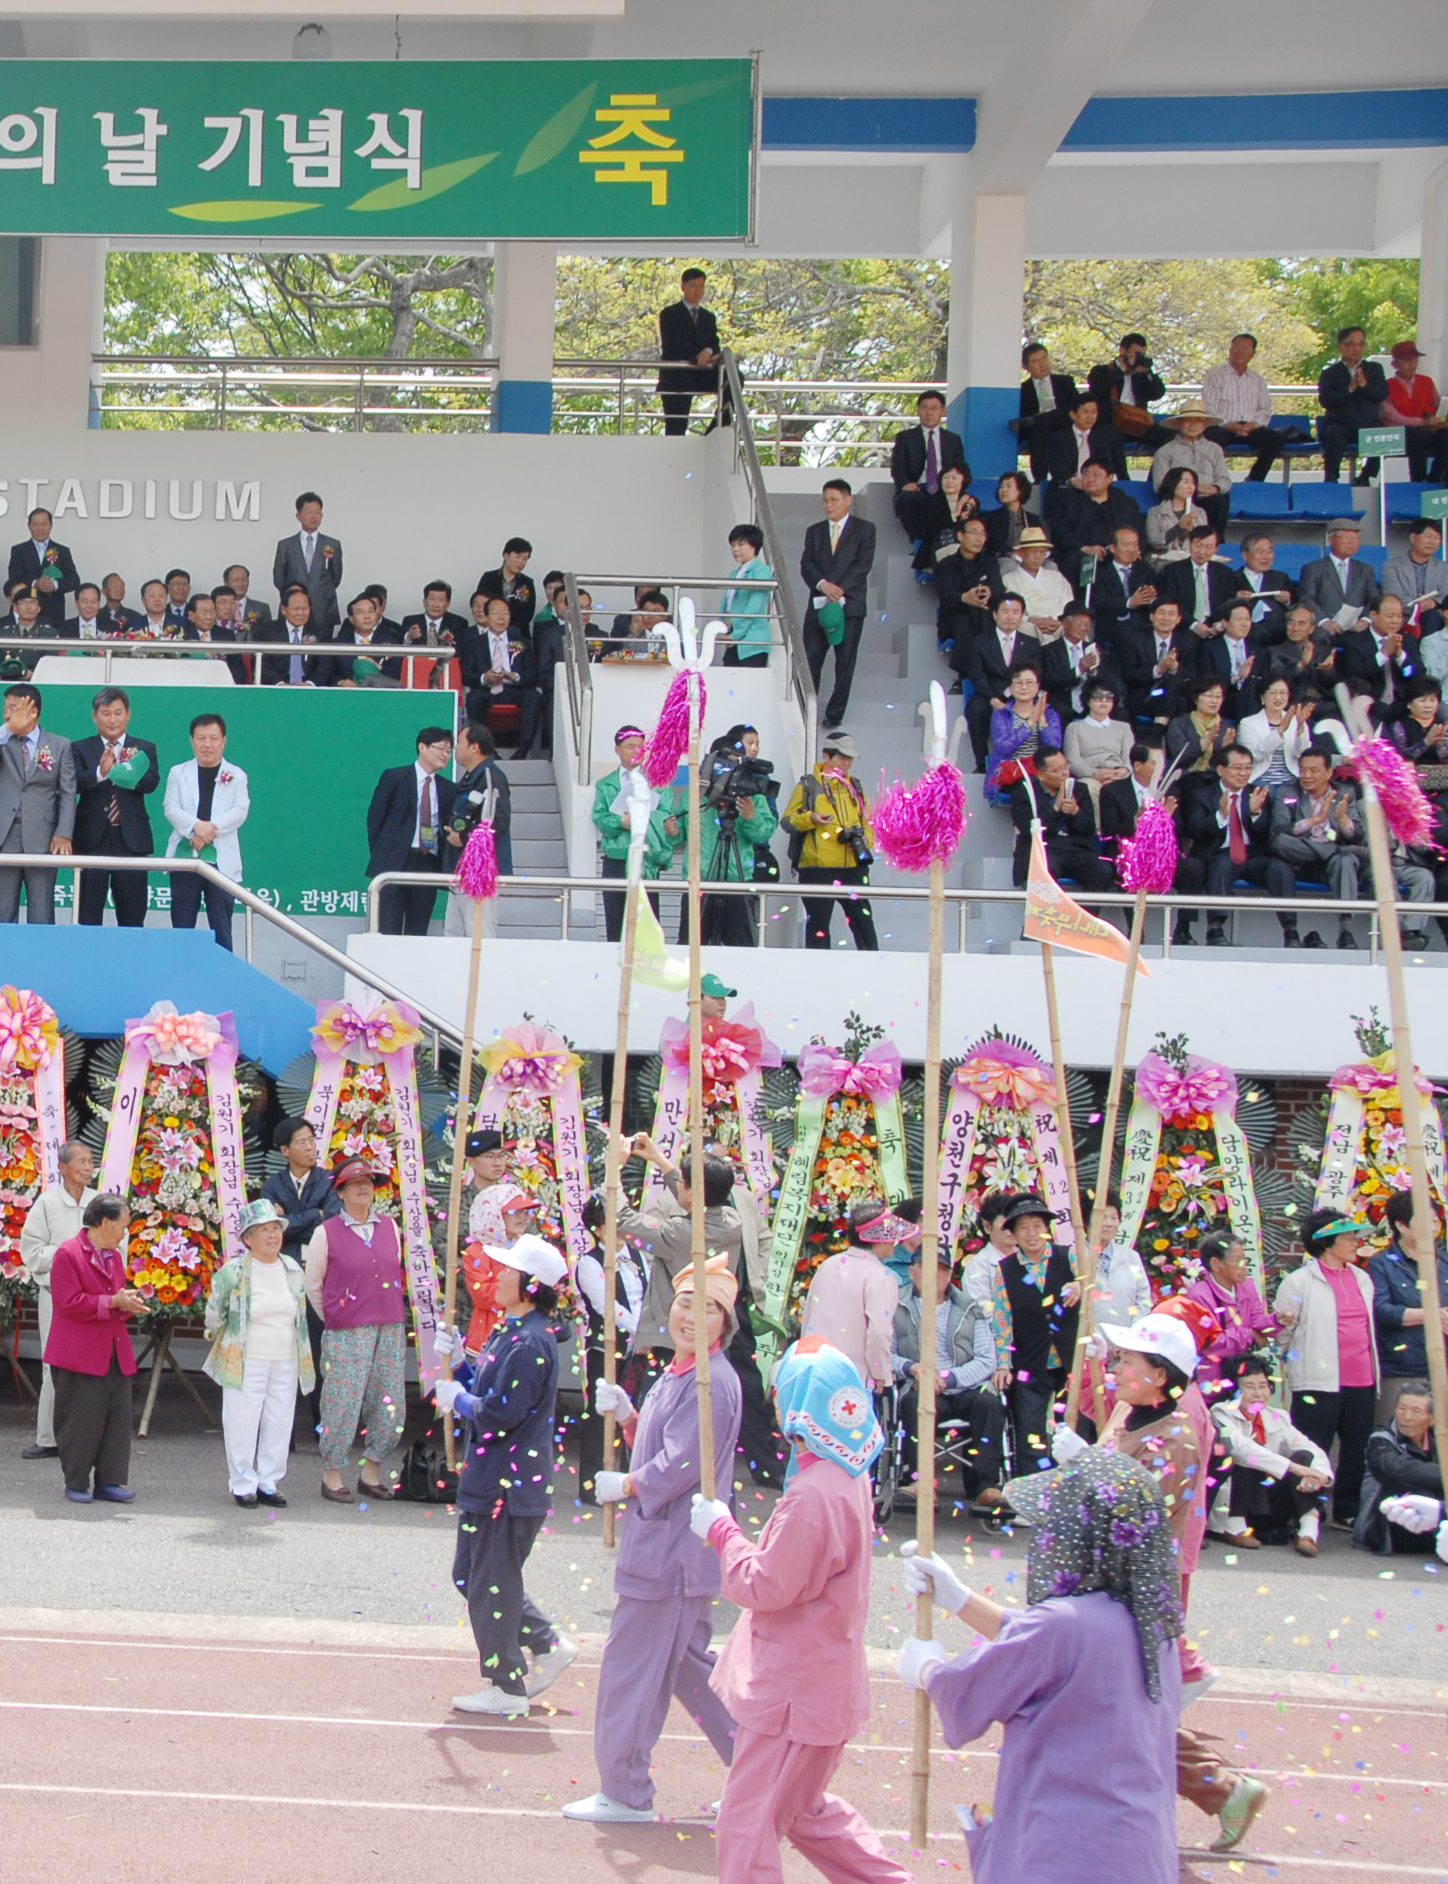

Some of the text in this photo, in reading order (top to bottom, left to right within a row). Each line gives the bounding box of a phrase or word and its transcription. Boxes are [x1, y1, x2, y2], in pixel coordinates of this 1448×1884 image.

[93, 107, 168, 187] 날
[198, 108, 424, 190] 기념식
[579, 93, 686, 206] 축
[216, 1093, 234, 1137] 김원기
[1034, 1114, 1058, 1134] 祝
[880, 1128, 902, 1156] 축
[1128, 1128, 1154, 1162] 慶祝
[220, 1144, 239, 1190] 회장님
[749, 1150, 772, 1190] 회장님
[394, 1085, 437, 1332] 김원기 회장님 수상을 축하드립니다
[563, 1169, 584, 1214] 회장님
[776, 1155, 811, 1248] 혜림복지재단
